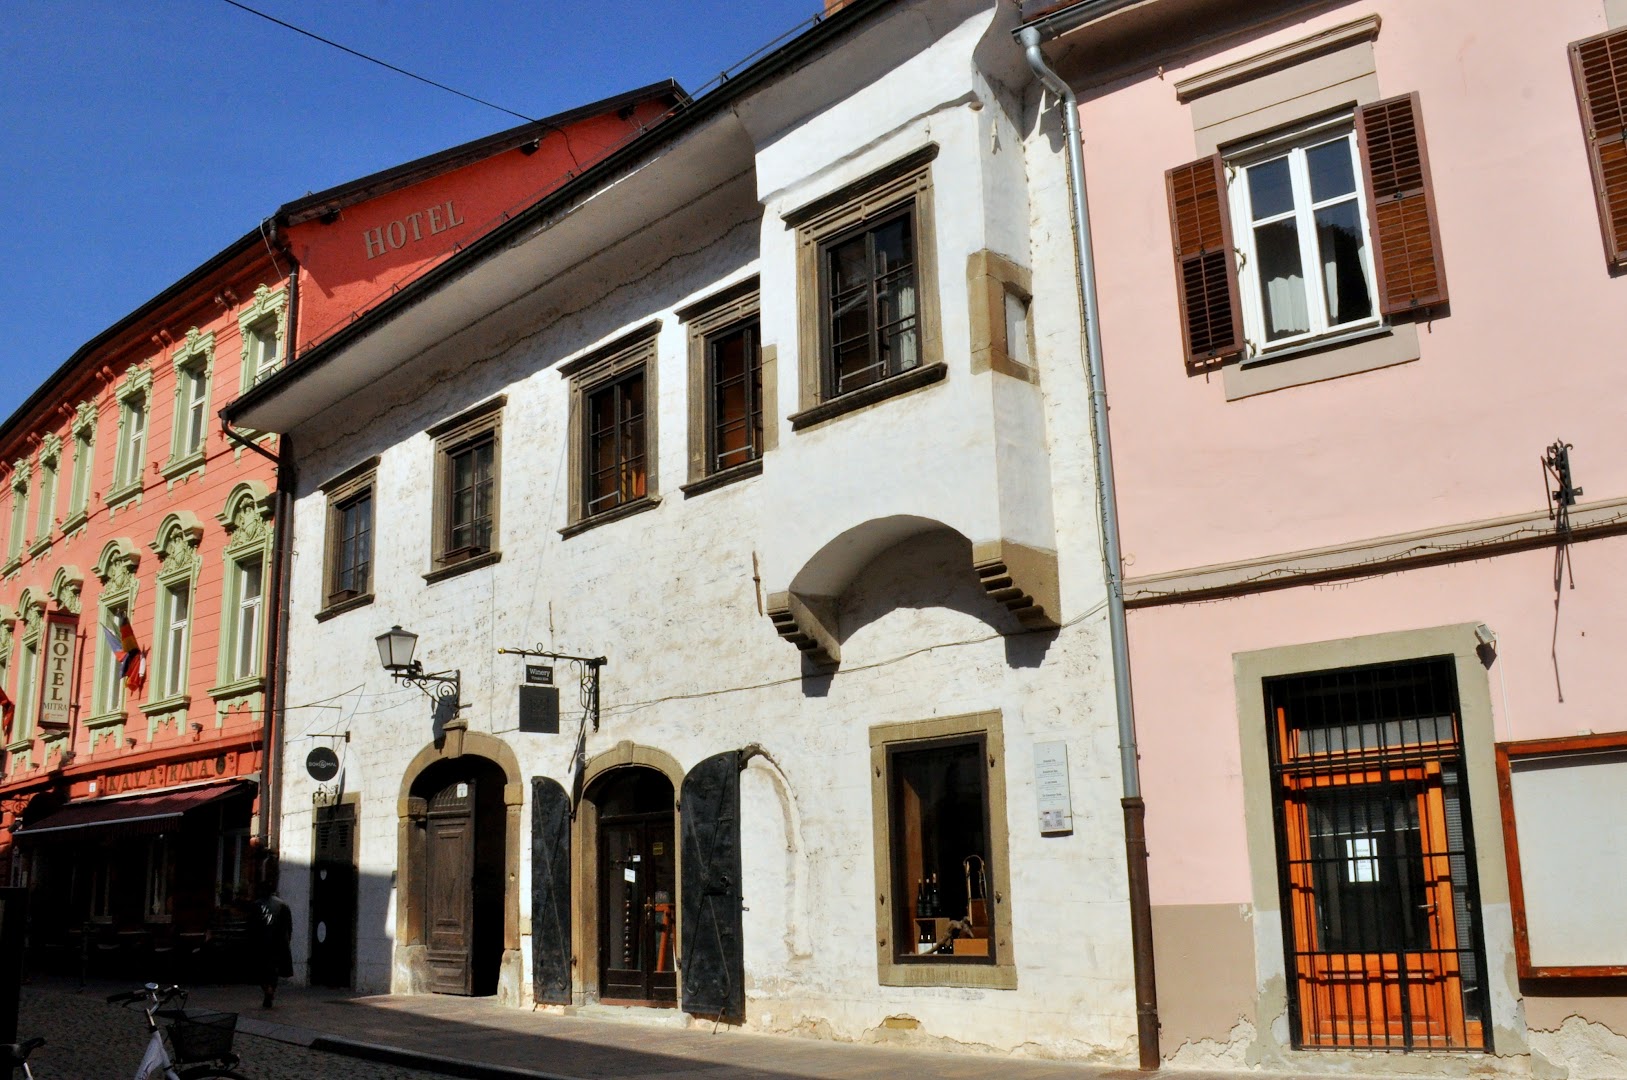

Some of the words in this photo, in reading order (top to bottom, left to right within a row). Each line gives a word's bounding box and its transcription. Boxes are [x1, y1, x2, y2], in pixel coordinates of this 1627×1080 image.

[363, 200, 464, 260] HOTEL
[52, 627, 70, 701] HOTEL
[529, 668, 551, 678] Winery
[43, 702, 68, 711] MITRA
